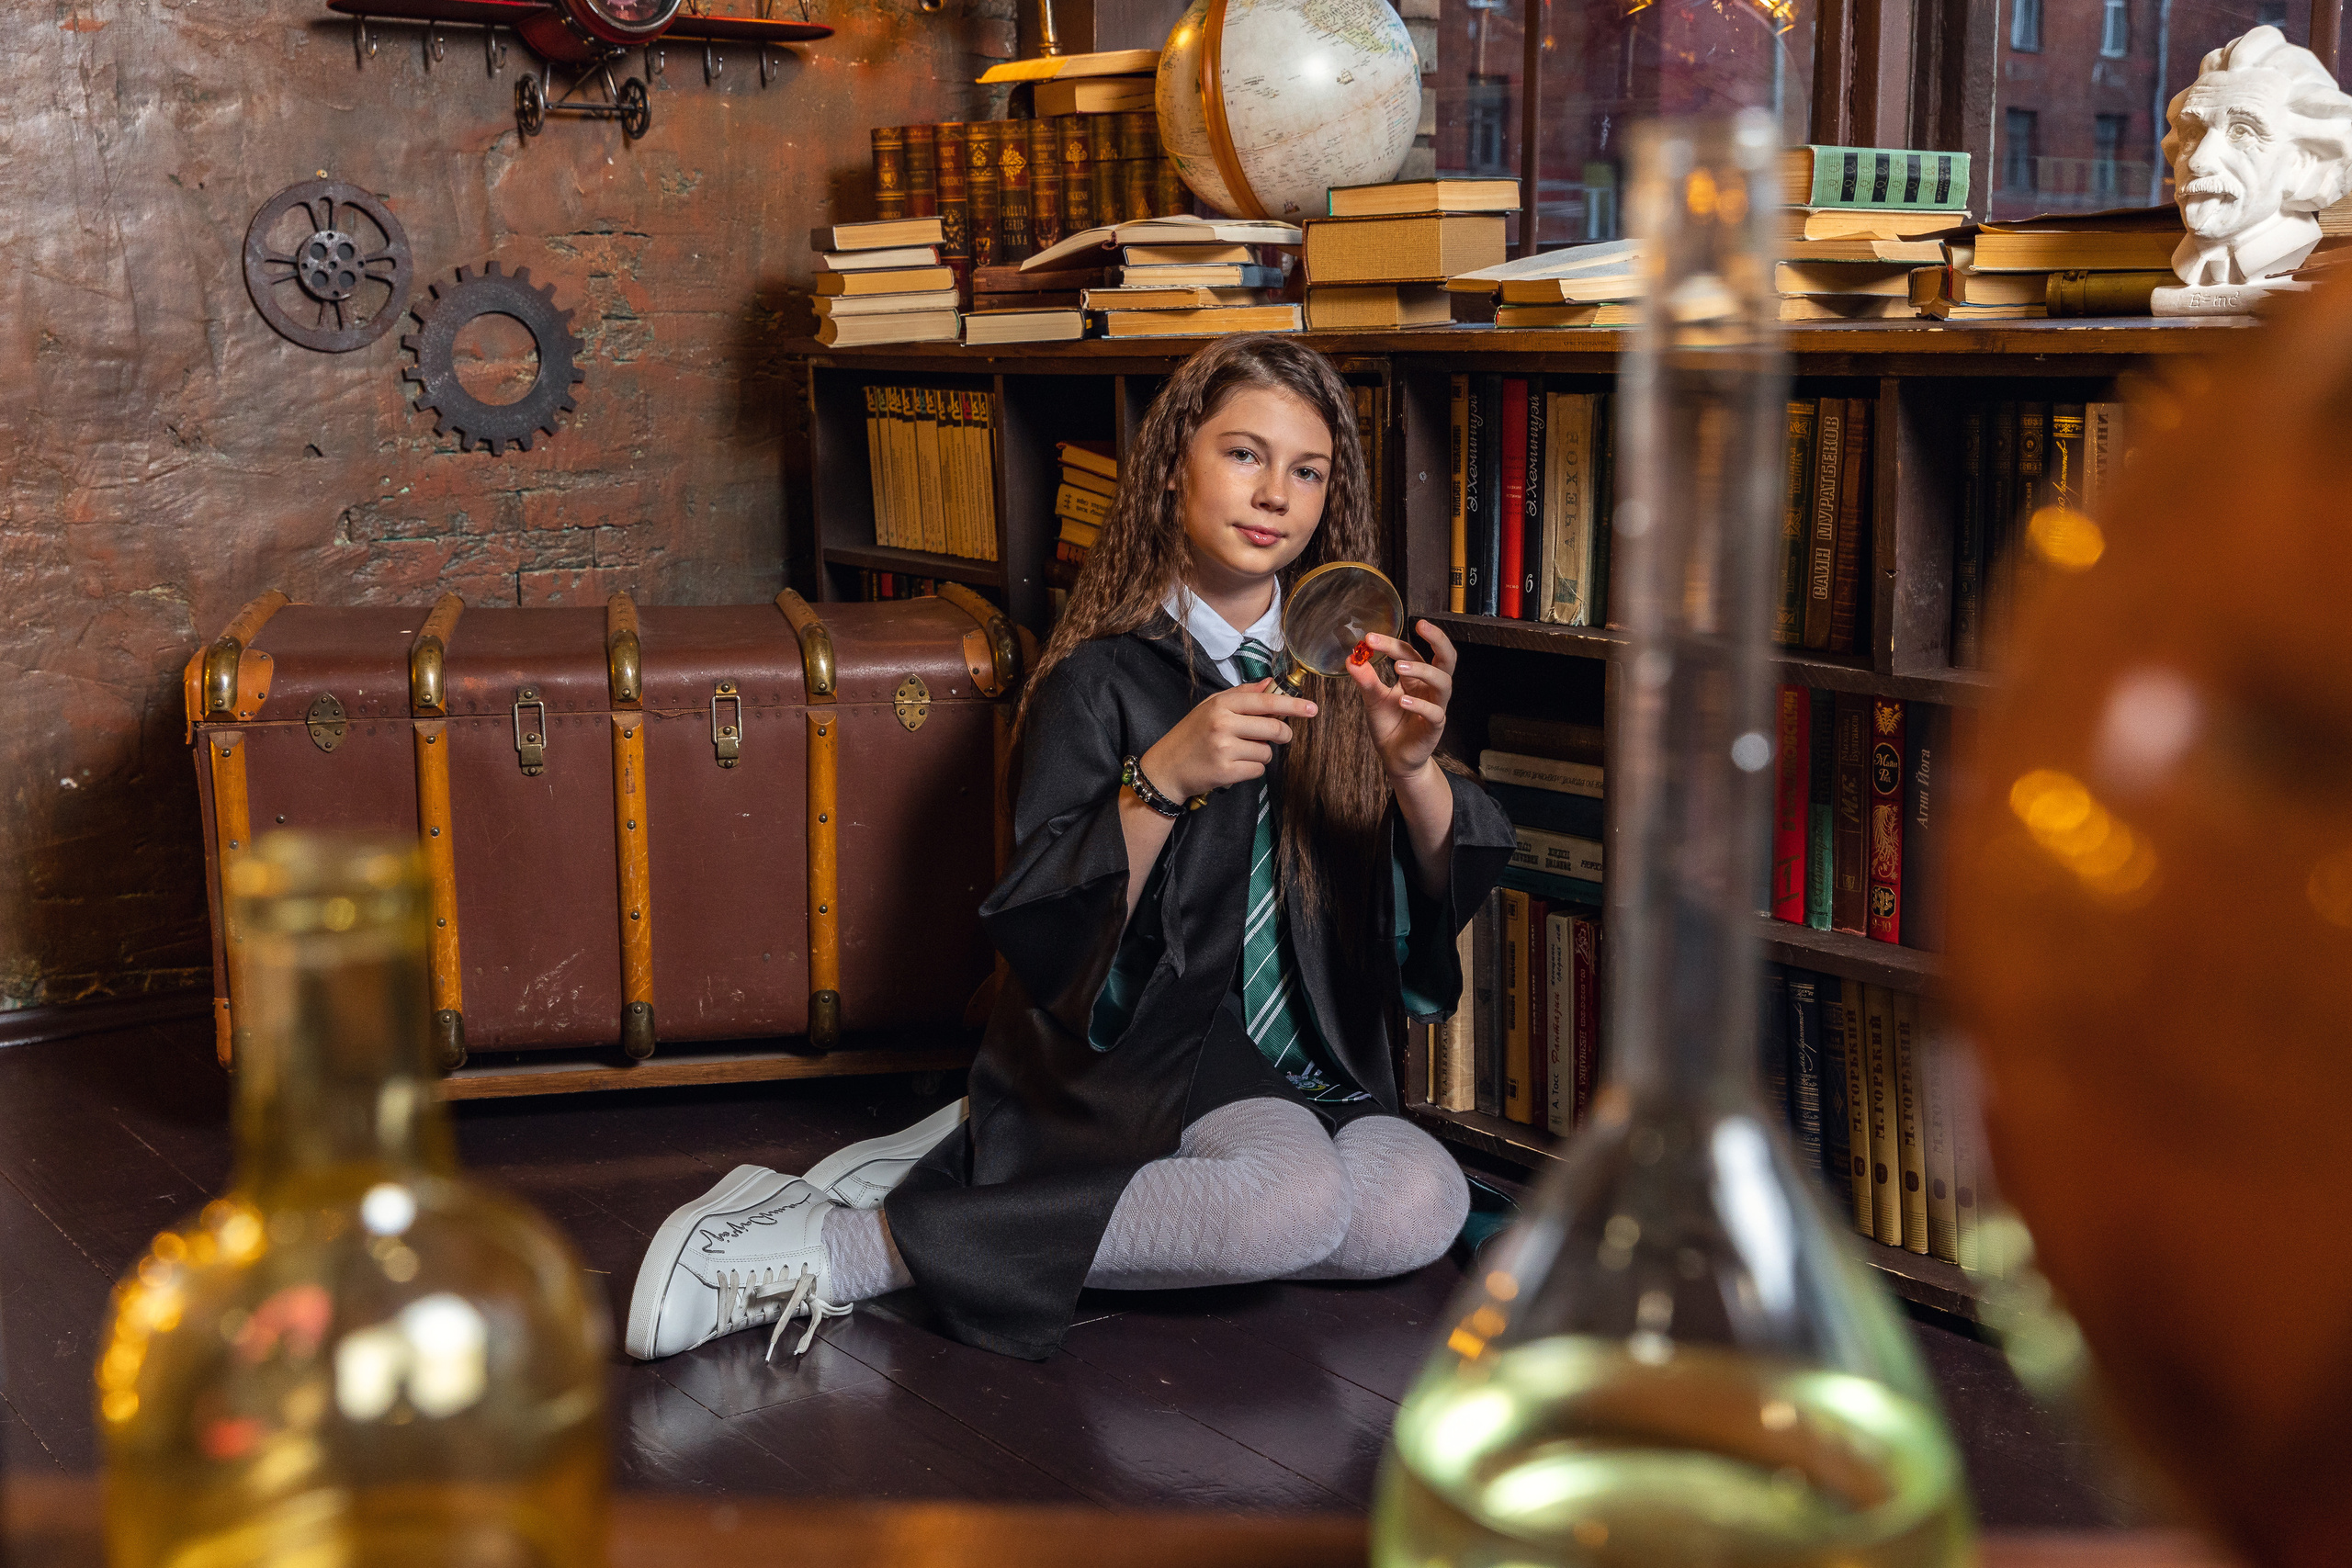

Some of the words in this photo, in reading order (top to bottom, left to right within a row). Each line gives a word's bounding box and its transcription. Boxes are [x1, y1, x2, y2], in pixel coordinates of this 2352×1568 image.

[1817, 415, 1839, 540] МУРАТБЕКОВ
[1812, 547, 1831, 600] САИН
[1841, 718, 1849, 761] Михаил
[1849, 715, 1860, 763] Булгаков
[1916, 749, 1930, 787] Йога
[1917, 791, 1928, 829] Агни
[1871, 919, 1892, 933] 9-10
[1551, 991, 1563, 1064] Фантазии
[1551, 1073, 1559, 1095] Тосс
[1552, 1098, 1559, 1109] А.
